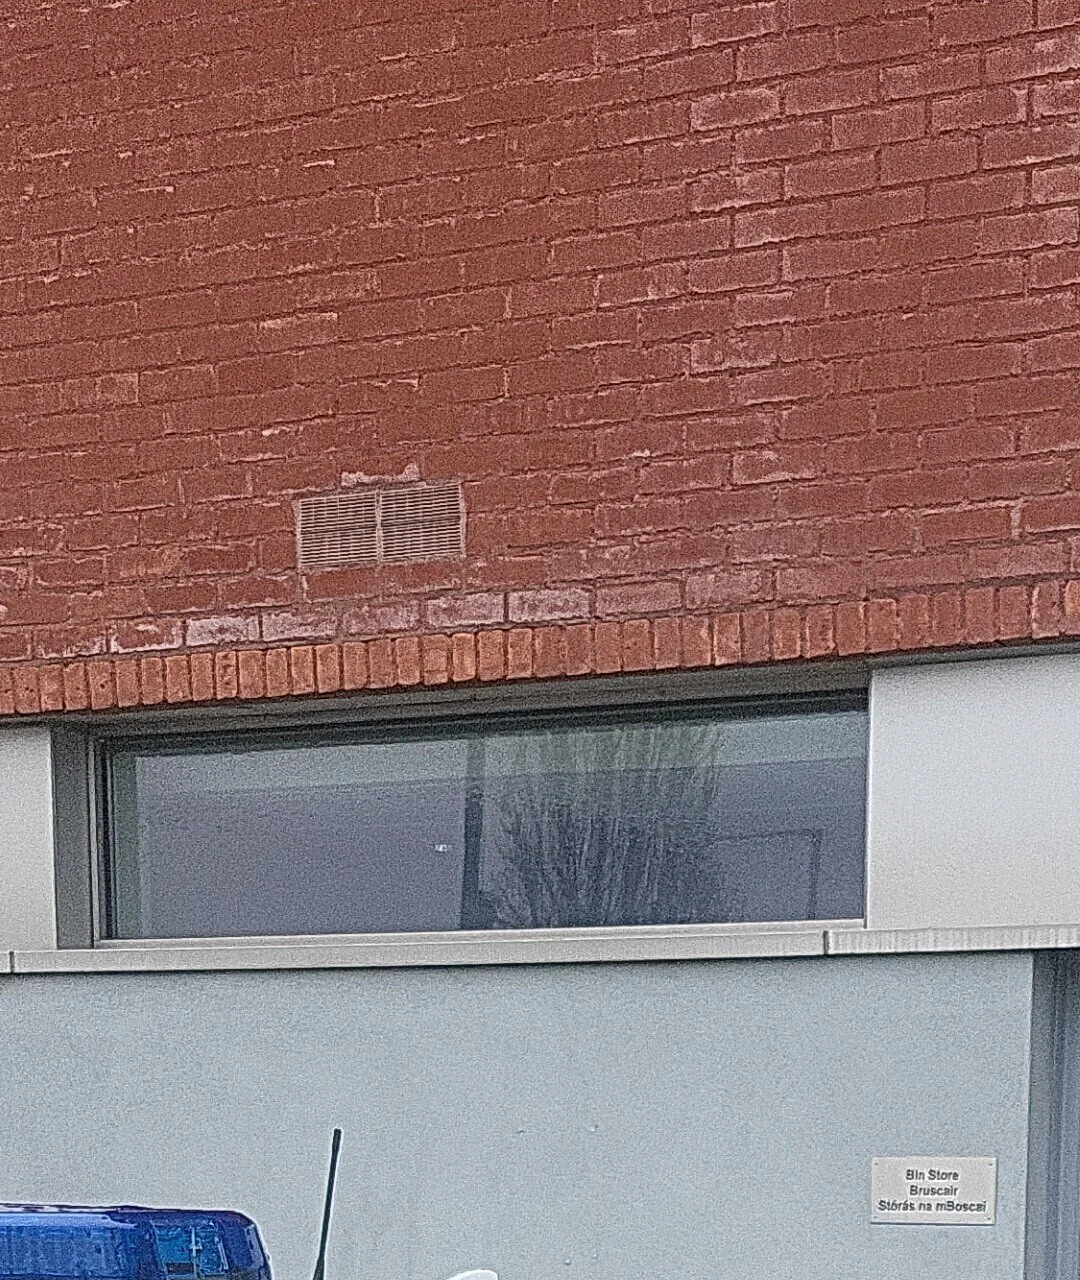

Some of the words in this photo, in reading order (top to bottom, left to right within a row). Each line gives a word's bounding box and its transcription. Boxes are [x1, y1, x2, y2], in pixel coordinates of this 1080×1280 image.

[905, 1169, 925, 1181] Bin
[927, 1169, 960, 1181] Store
[909, 1185, 958, 1196] Bruscair
[918, 1203, 932, 1212] na
